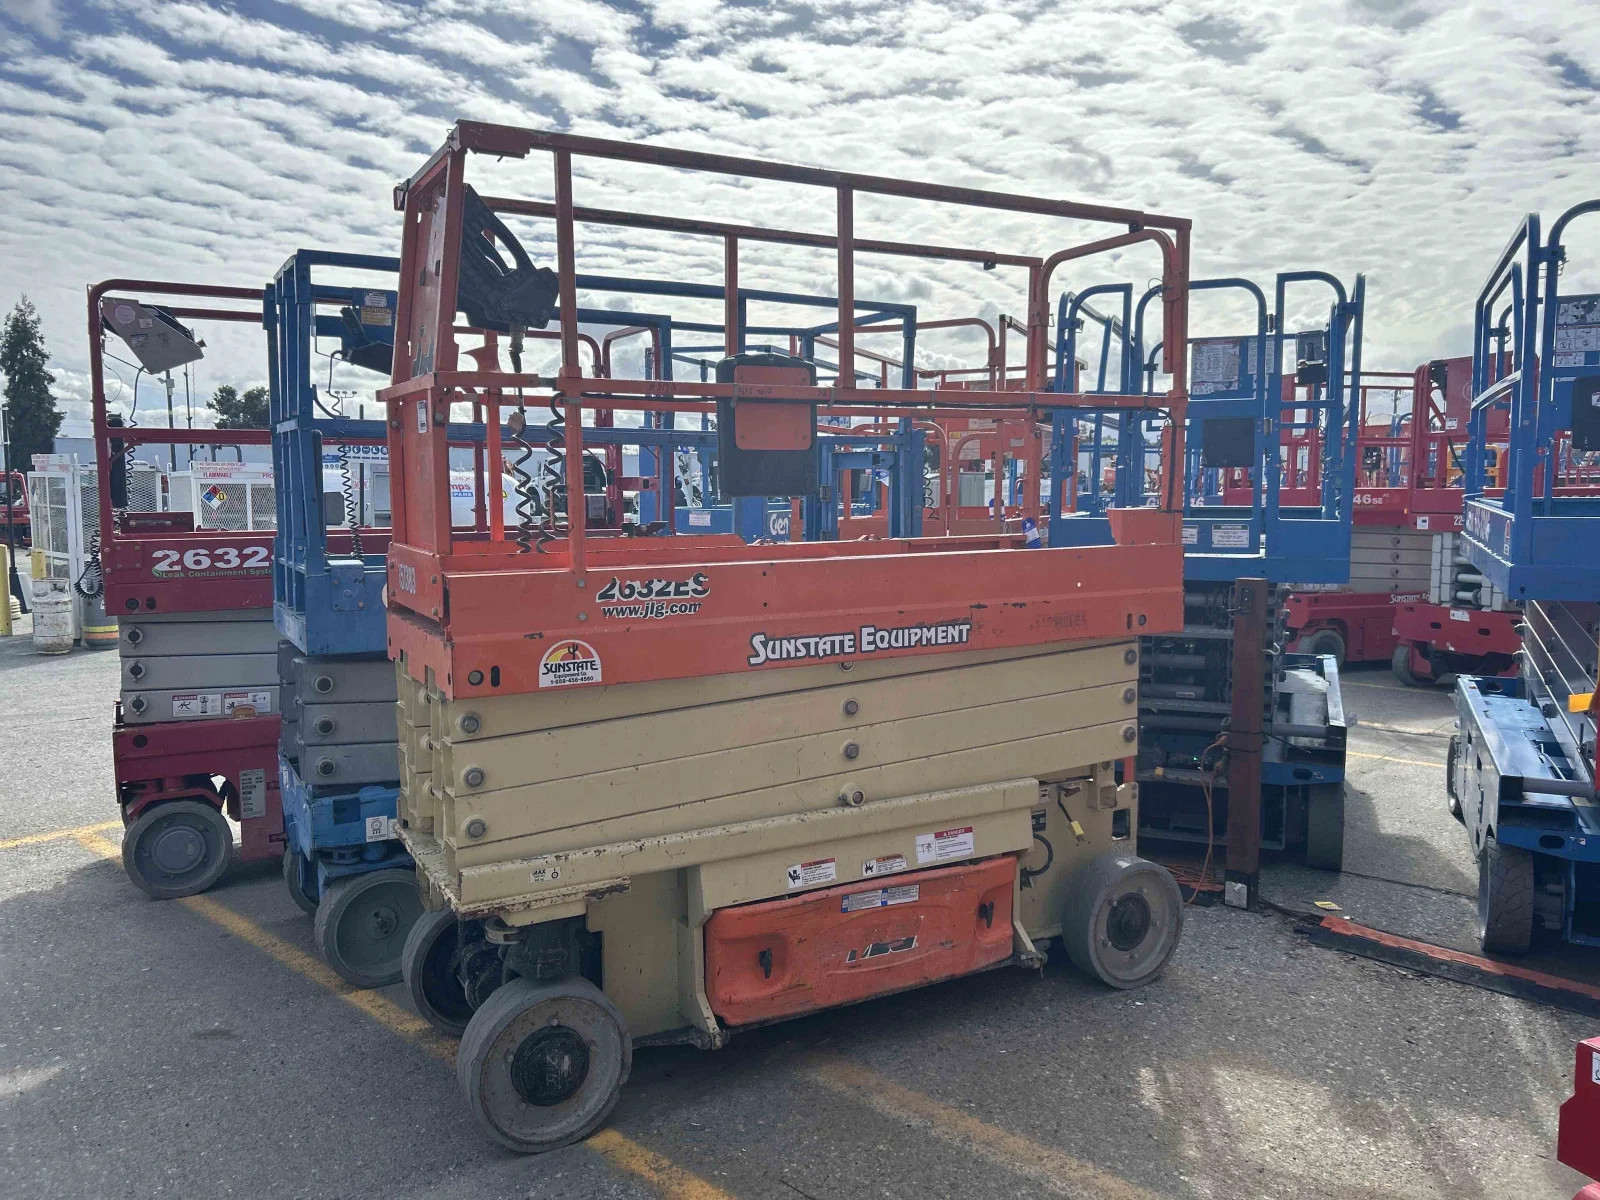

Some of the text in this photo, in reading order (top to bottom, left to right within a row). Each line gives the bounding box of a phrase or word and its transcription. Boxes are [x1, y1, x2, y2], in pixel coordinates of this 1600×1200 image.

[362, 306, 392, 314] DANGER
[769, 513, 781, 536] Gen
[152, 546, 274, 572] 2632
[162, 570, 185, 578] Leak
[188, 569, 247, 578] Containment
[596, 573, 711, 602] 2632ES
[748, 624, 972, 666] SUNSTATE EQUIPMENT
[542, 660, 599, 676] SUNSTATE
[947, 828, 965, 836] DANGER
